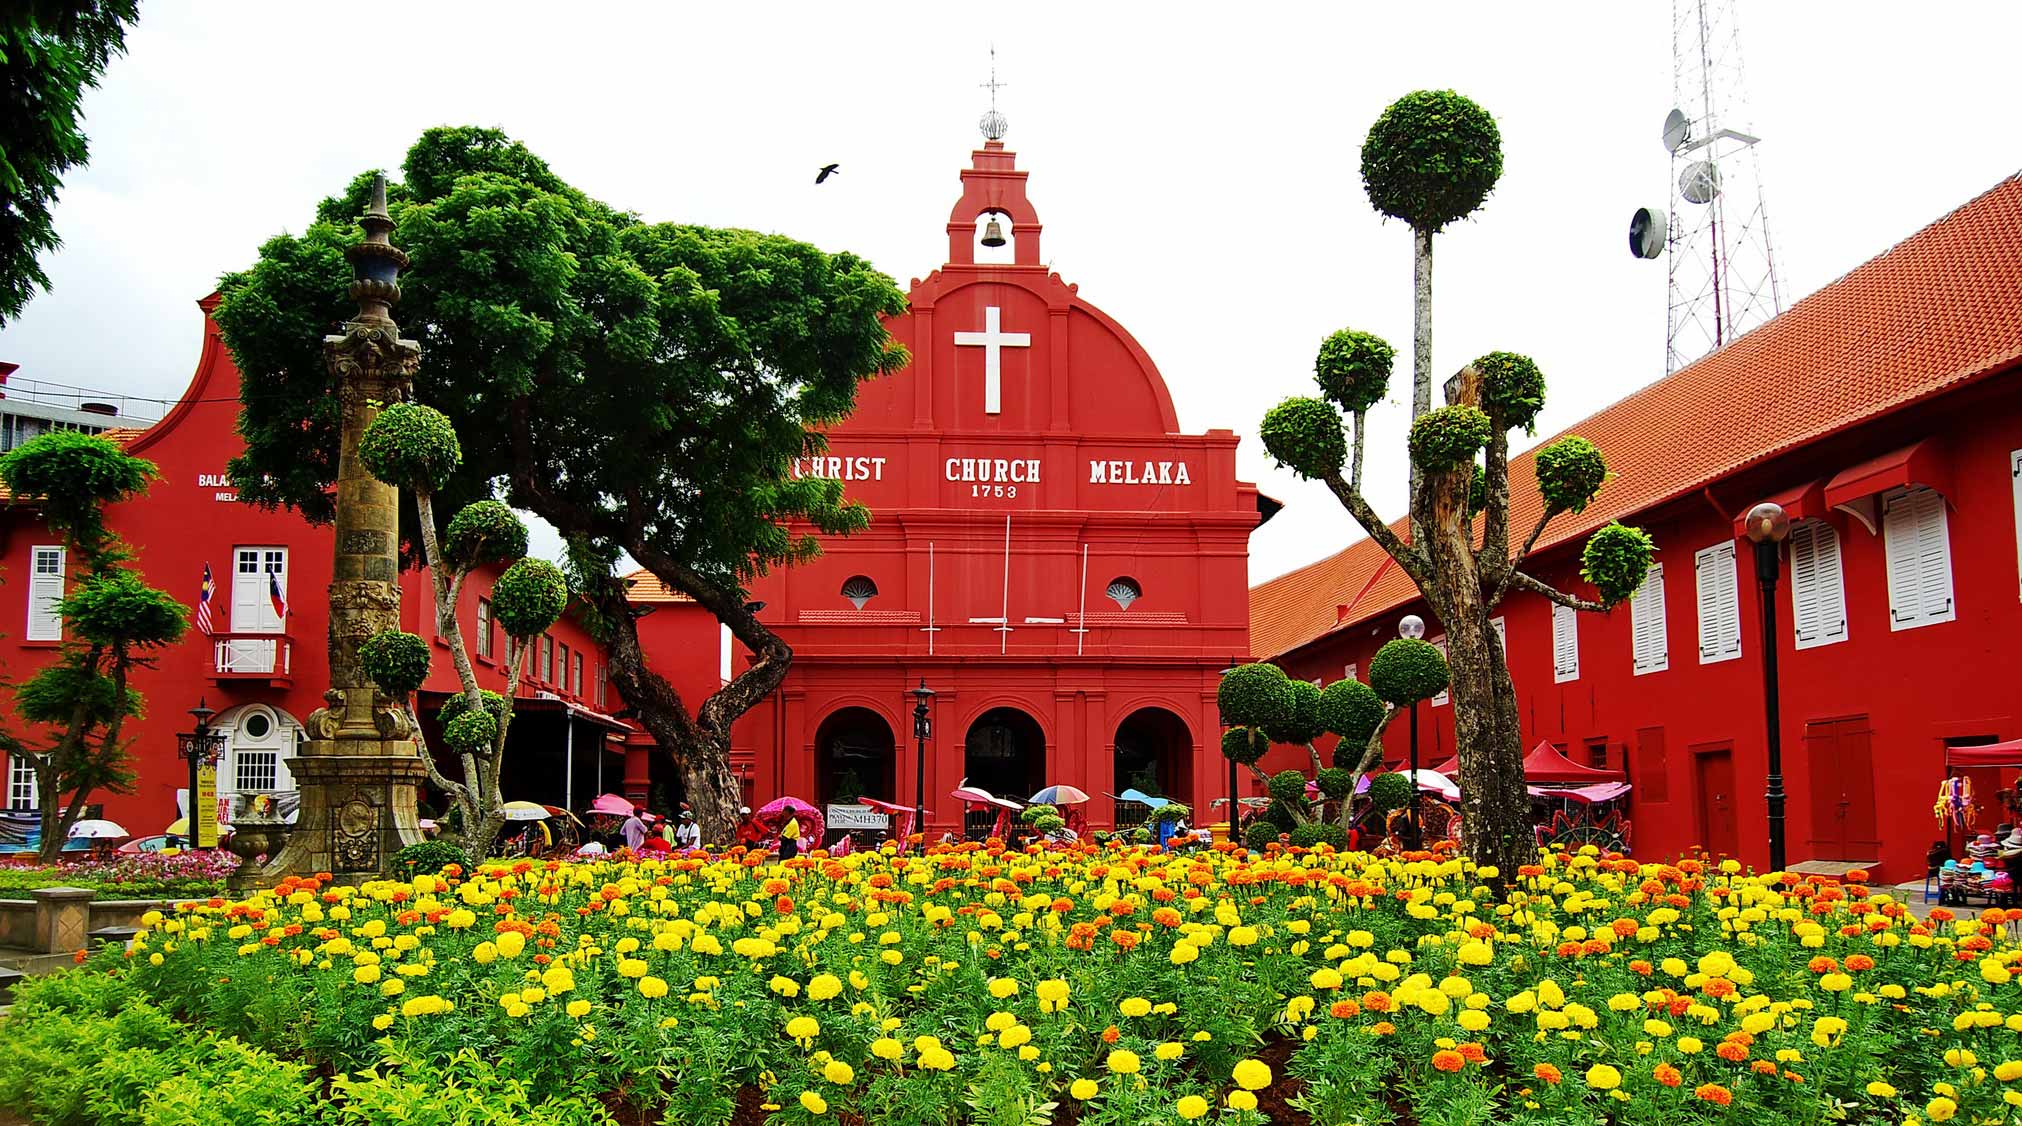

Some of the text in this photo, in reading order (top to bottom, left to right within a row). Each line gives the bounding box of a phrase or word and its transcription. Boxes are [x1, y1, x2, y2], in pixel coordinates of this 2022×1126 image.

[794, 456, 1191, 485] CHRIST CHURCH MELAKA
[198, 474, 231, 487] BALA
[971, 485, 1017, 499] 1753
[853, 815, 888, 825] MH370
